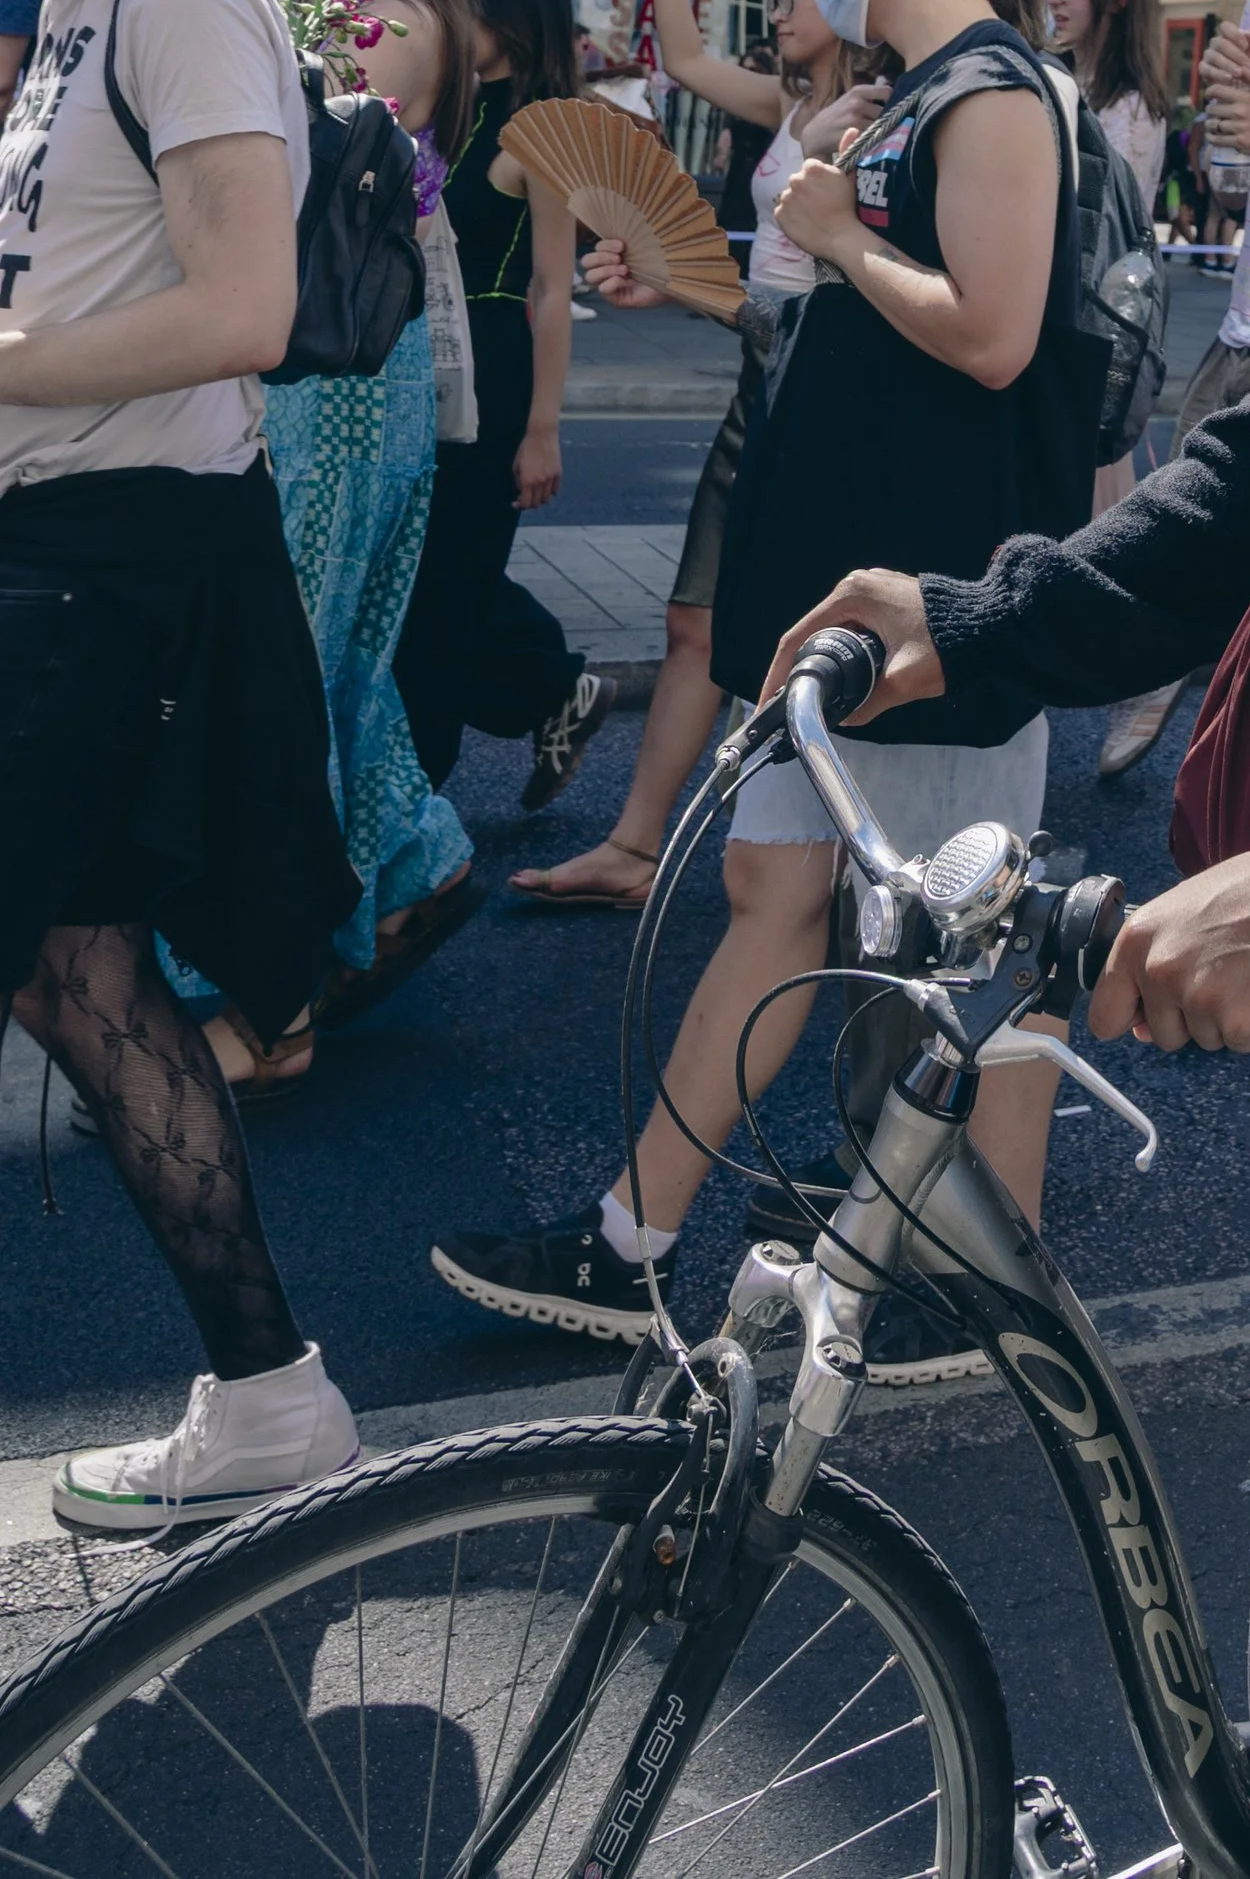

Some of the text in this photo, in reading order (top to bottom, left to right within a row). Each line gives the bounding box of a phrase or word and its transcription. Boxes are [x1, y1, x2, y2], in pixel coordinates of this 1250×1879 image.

[0, 254, 32, 309] T
[814, 638, 854, 660] SRAM
[1000, 1331, 1213, 1778] ORBEA
